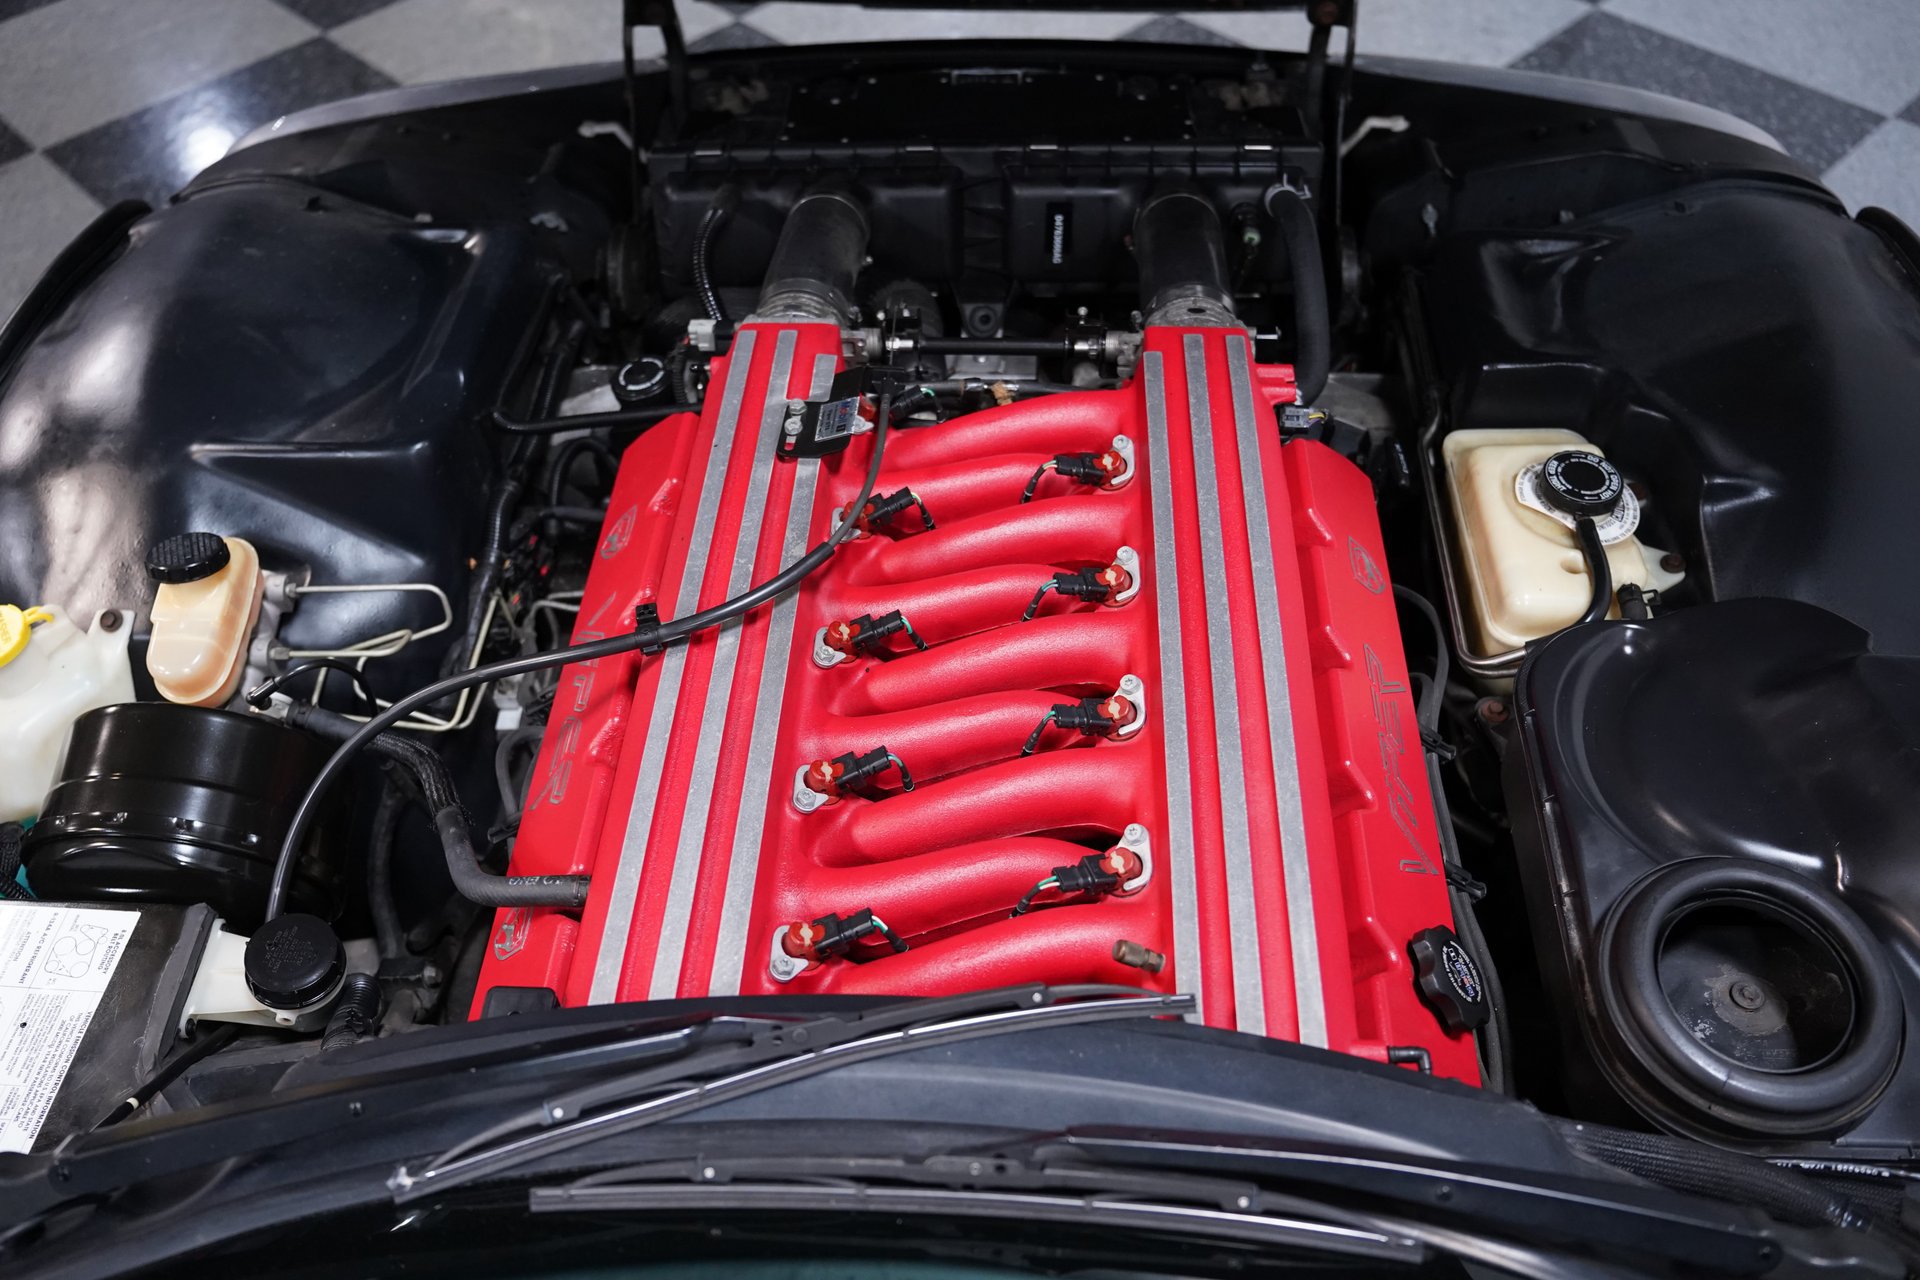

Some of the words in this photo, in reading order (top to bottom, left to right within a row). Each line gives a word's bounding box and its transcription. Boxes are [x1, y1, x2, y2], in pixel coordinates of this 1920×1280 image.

[1547, 460, 1559, 475] KEEP
[1587, 454, 1600, 463] DO
[1599, 461, 1614, 474] NOT
[1549, 475, 1567, 492] TIGHT
[1610, 474, 1619, 492] OPEN
[1599, 489, 1614, 500] HOT
[12, 931, 31, 961] ATTENTION
[38, 932, 48, 943] A/C
[109, 932, 119, 944] BELT
[17, 945, 41, 983] REFRIGERANT
[97, 945, 112, 969] ROUTING
[101, 941, 120, 973] ACCESSORY
[78, 1011, 91, 1033] VEHICLE
[65, 1035, 80, 1063] EMISSION
[50, 1064, 66, 1094] CONTROL
[29, 1096, 52, 1139] INFORMATION
